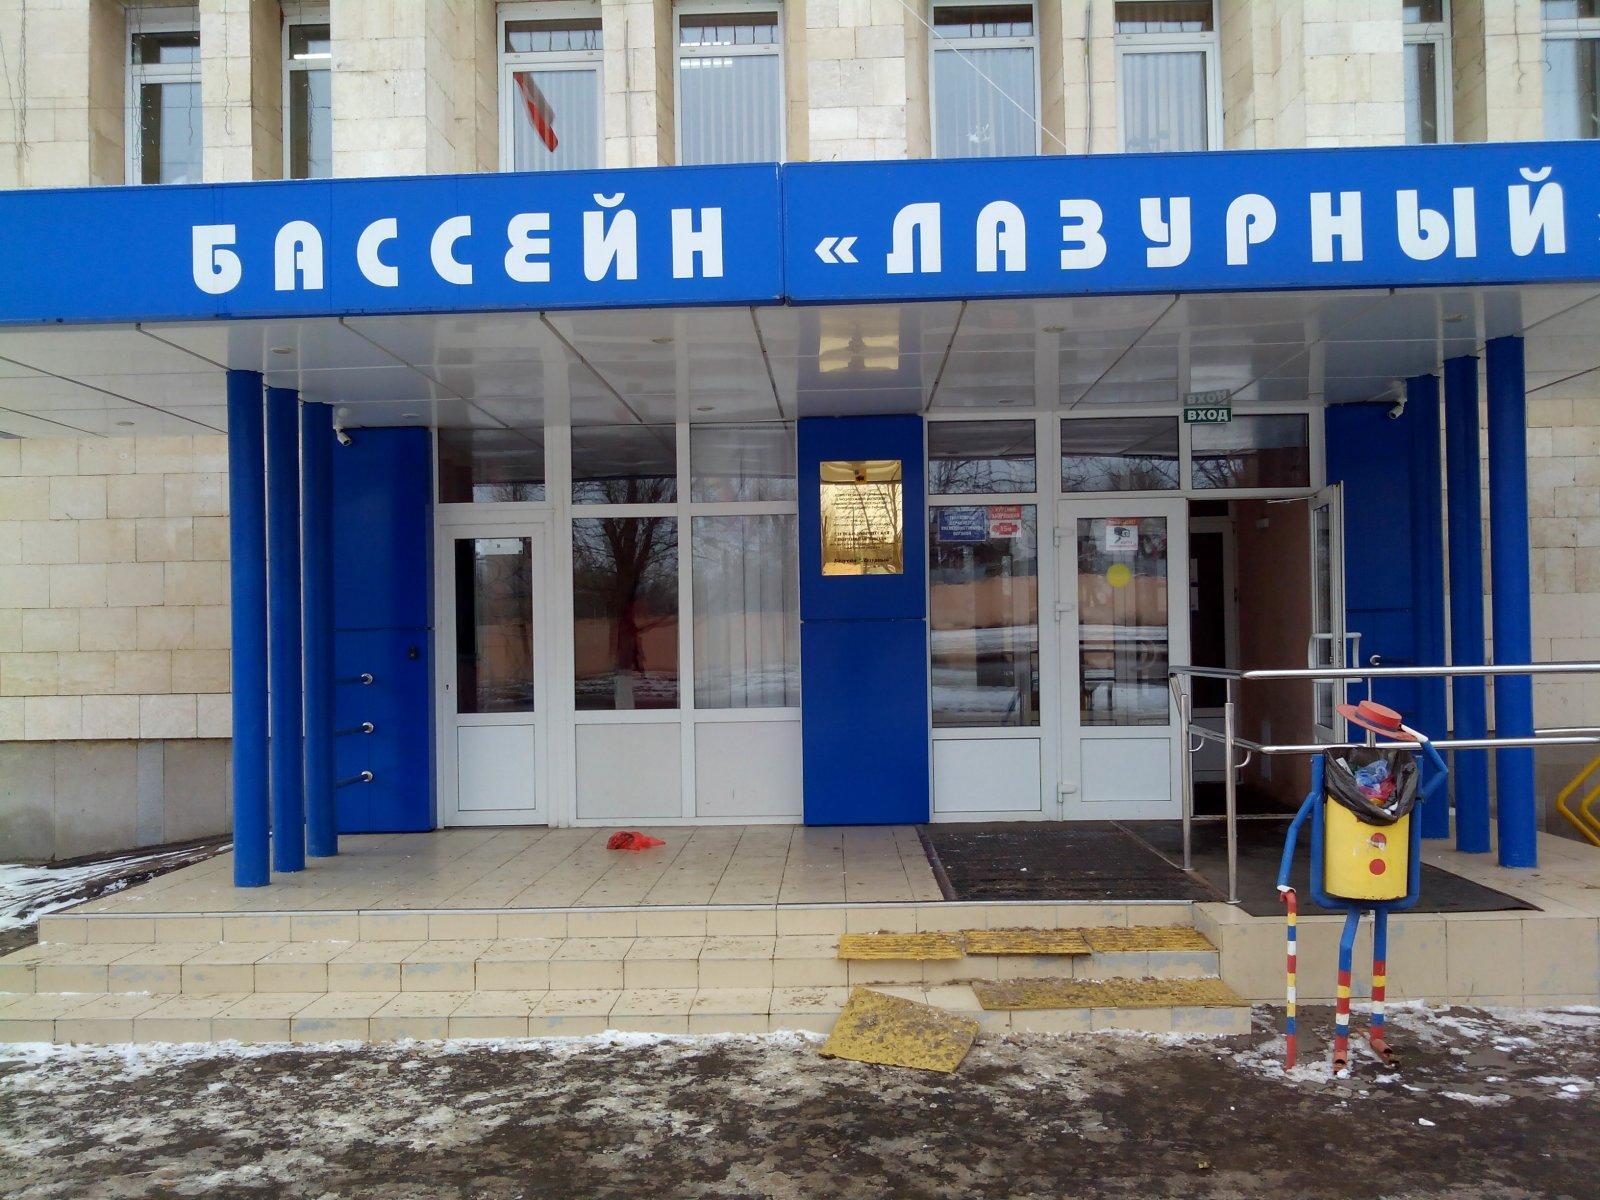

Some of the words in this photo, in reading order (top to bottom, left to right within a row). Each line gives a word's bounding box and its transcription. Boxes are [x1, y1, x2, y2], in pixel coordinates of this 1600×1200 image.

[192, 192, 724, 295] БАССЕЙН
[814, 165, 1600, 276] «ЛАЗУРНЫЙ
[1187, 409, 1228, 421] ВХОД
